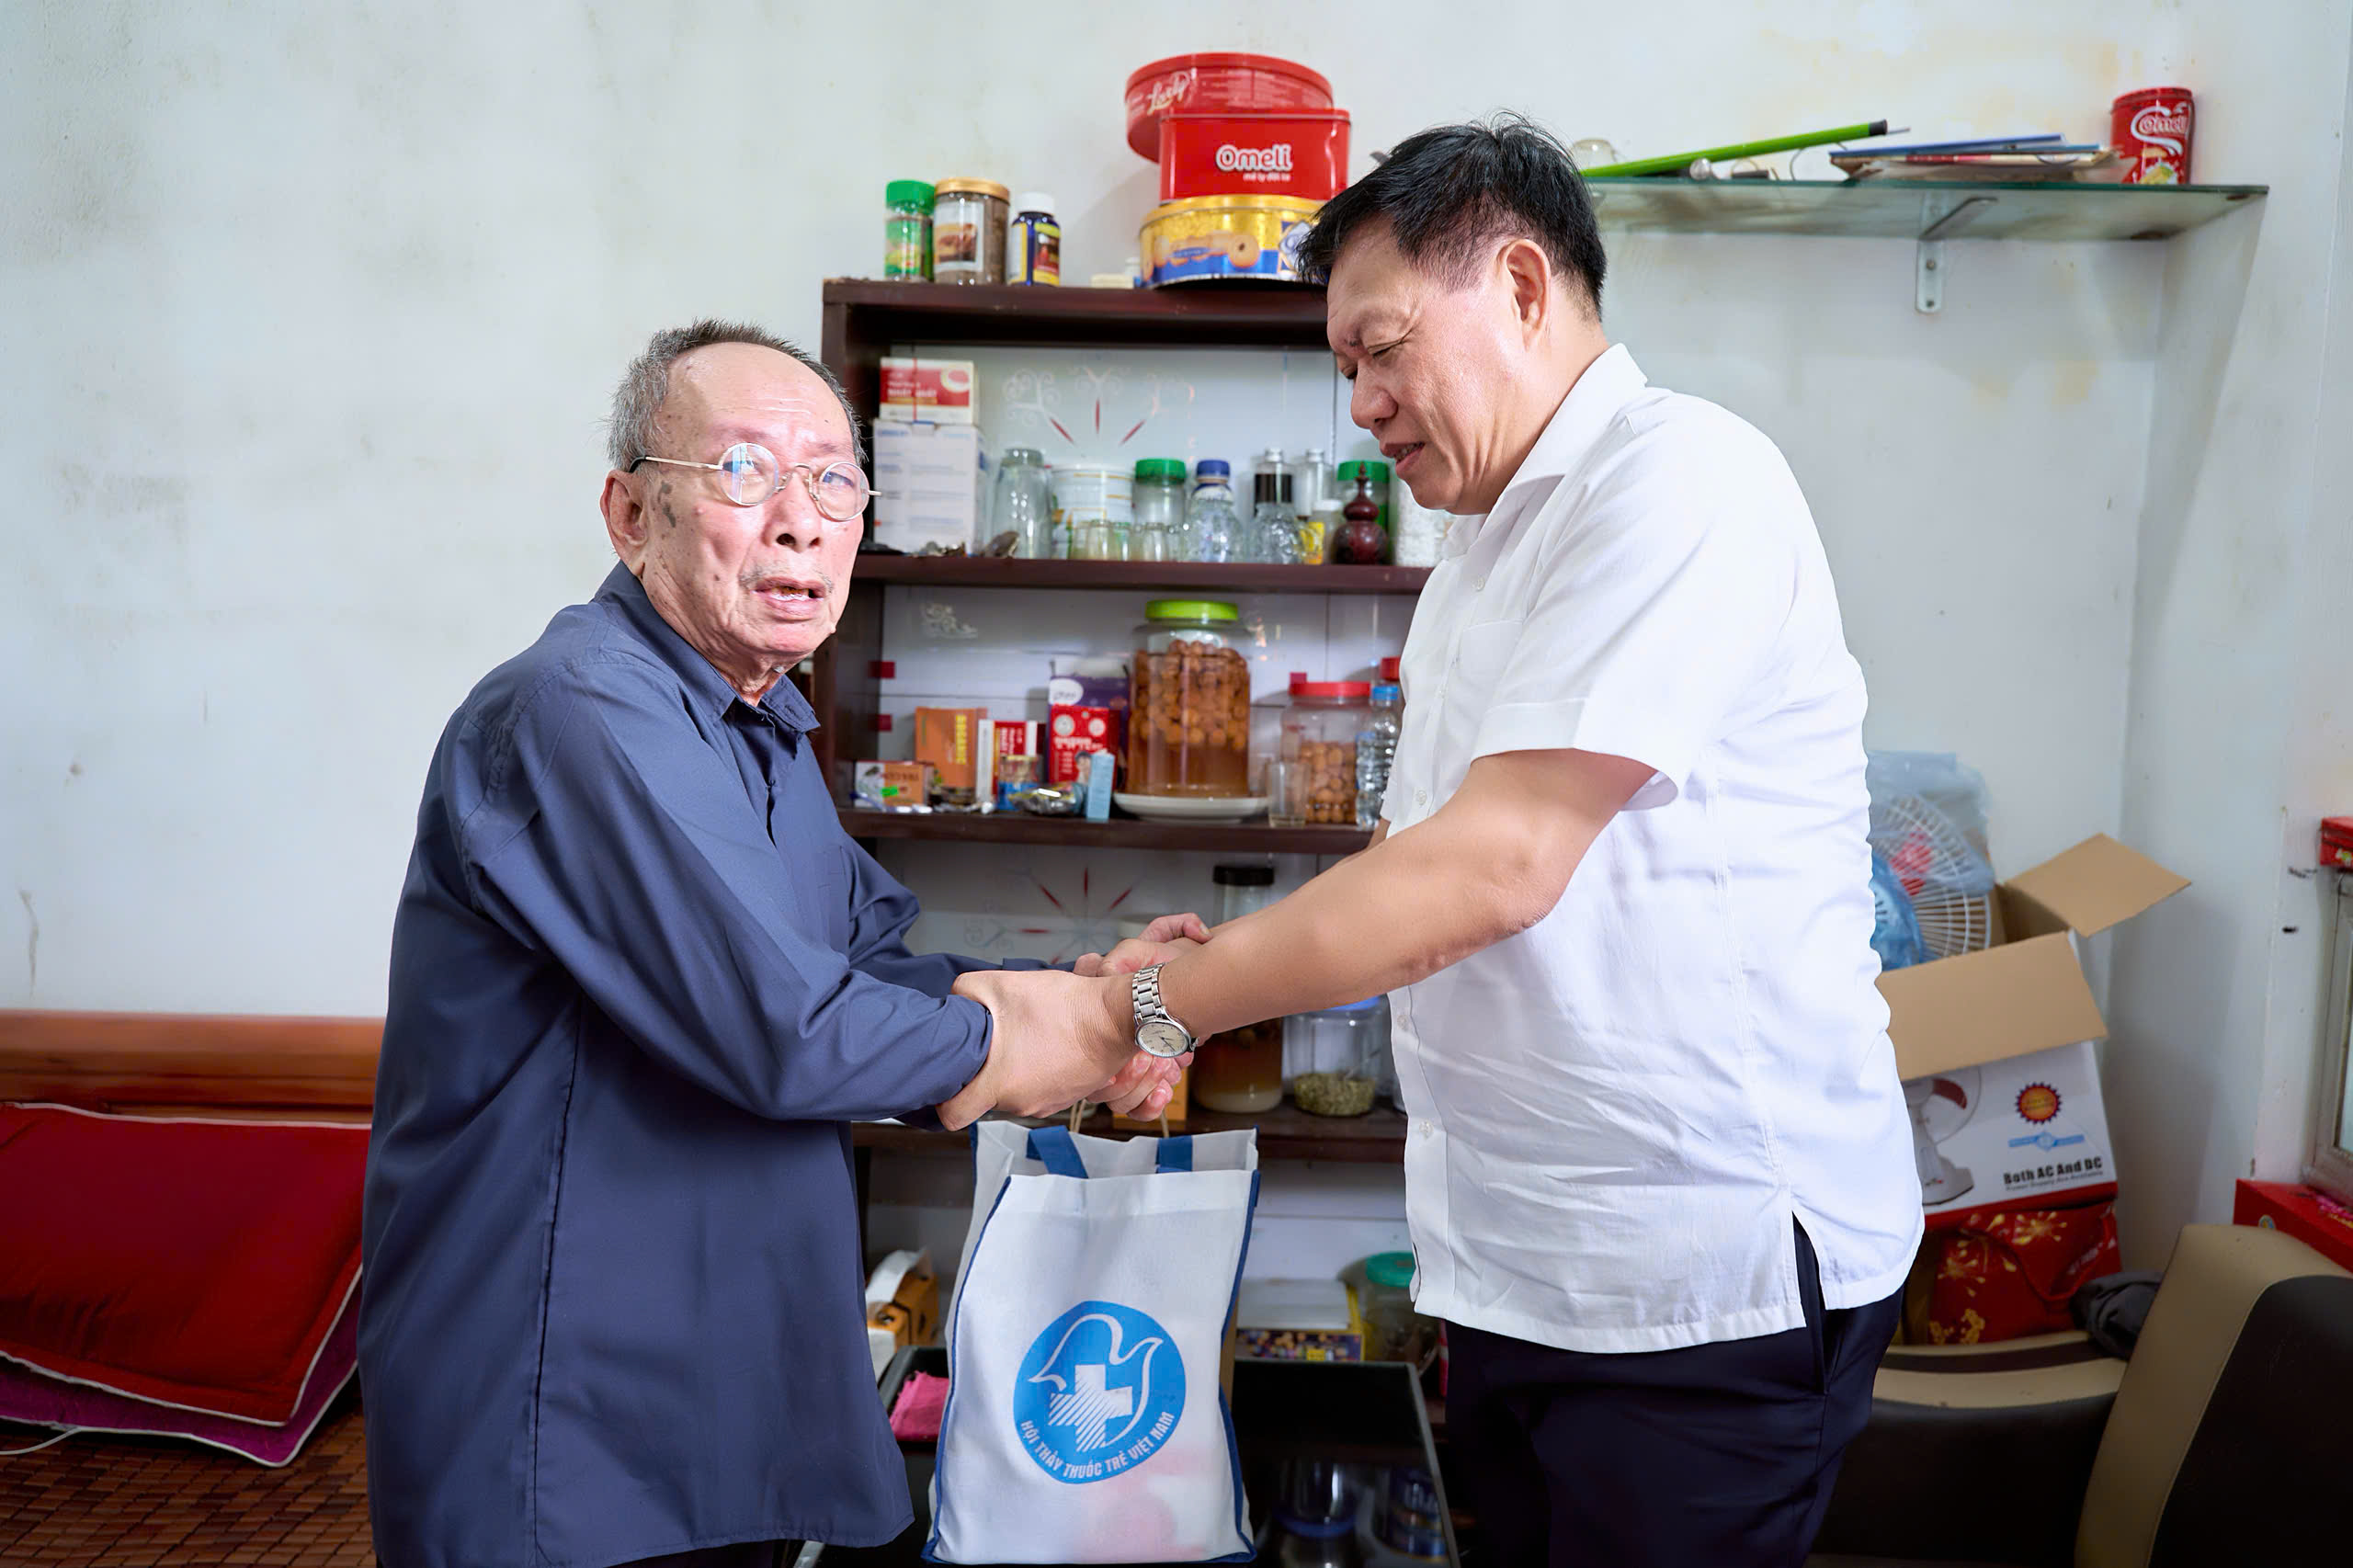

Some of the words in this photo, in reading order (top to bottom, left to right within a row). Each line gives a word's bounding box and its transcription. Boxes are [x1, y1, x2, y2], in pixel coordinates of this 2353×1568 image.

[1215, 143, 1293, 172] Omeli
[2003, 1168, 2035, 1185] Both
[2037, 1165, 2054, 1178] AC
[2056, 1161, 2082, 1176] And
[2084, 1156, 2102, 1170] DC
[1020, 1419, 1040, 1444] HỘI
[1063, 1459, 1102, 1479] THUỐC
[1105, 1450, 1129, 1472] TRẺ
[1128, 1436, 1155, 1460] VIỆT
[1149, 1411, 1175, 1440] NAM
